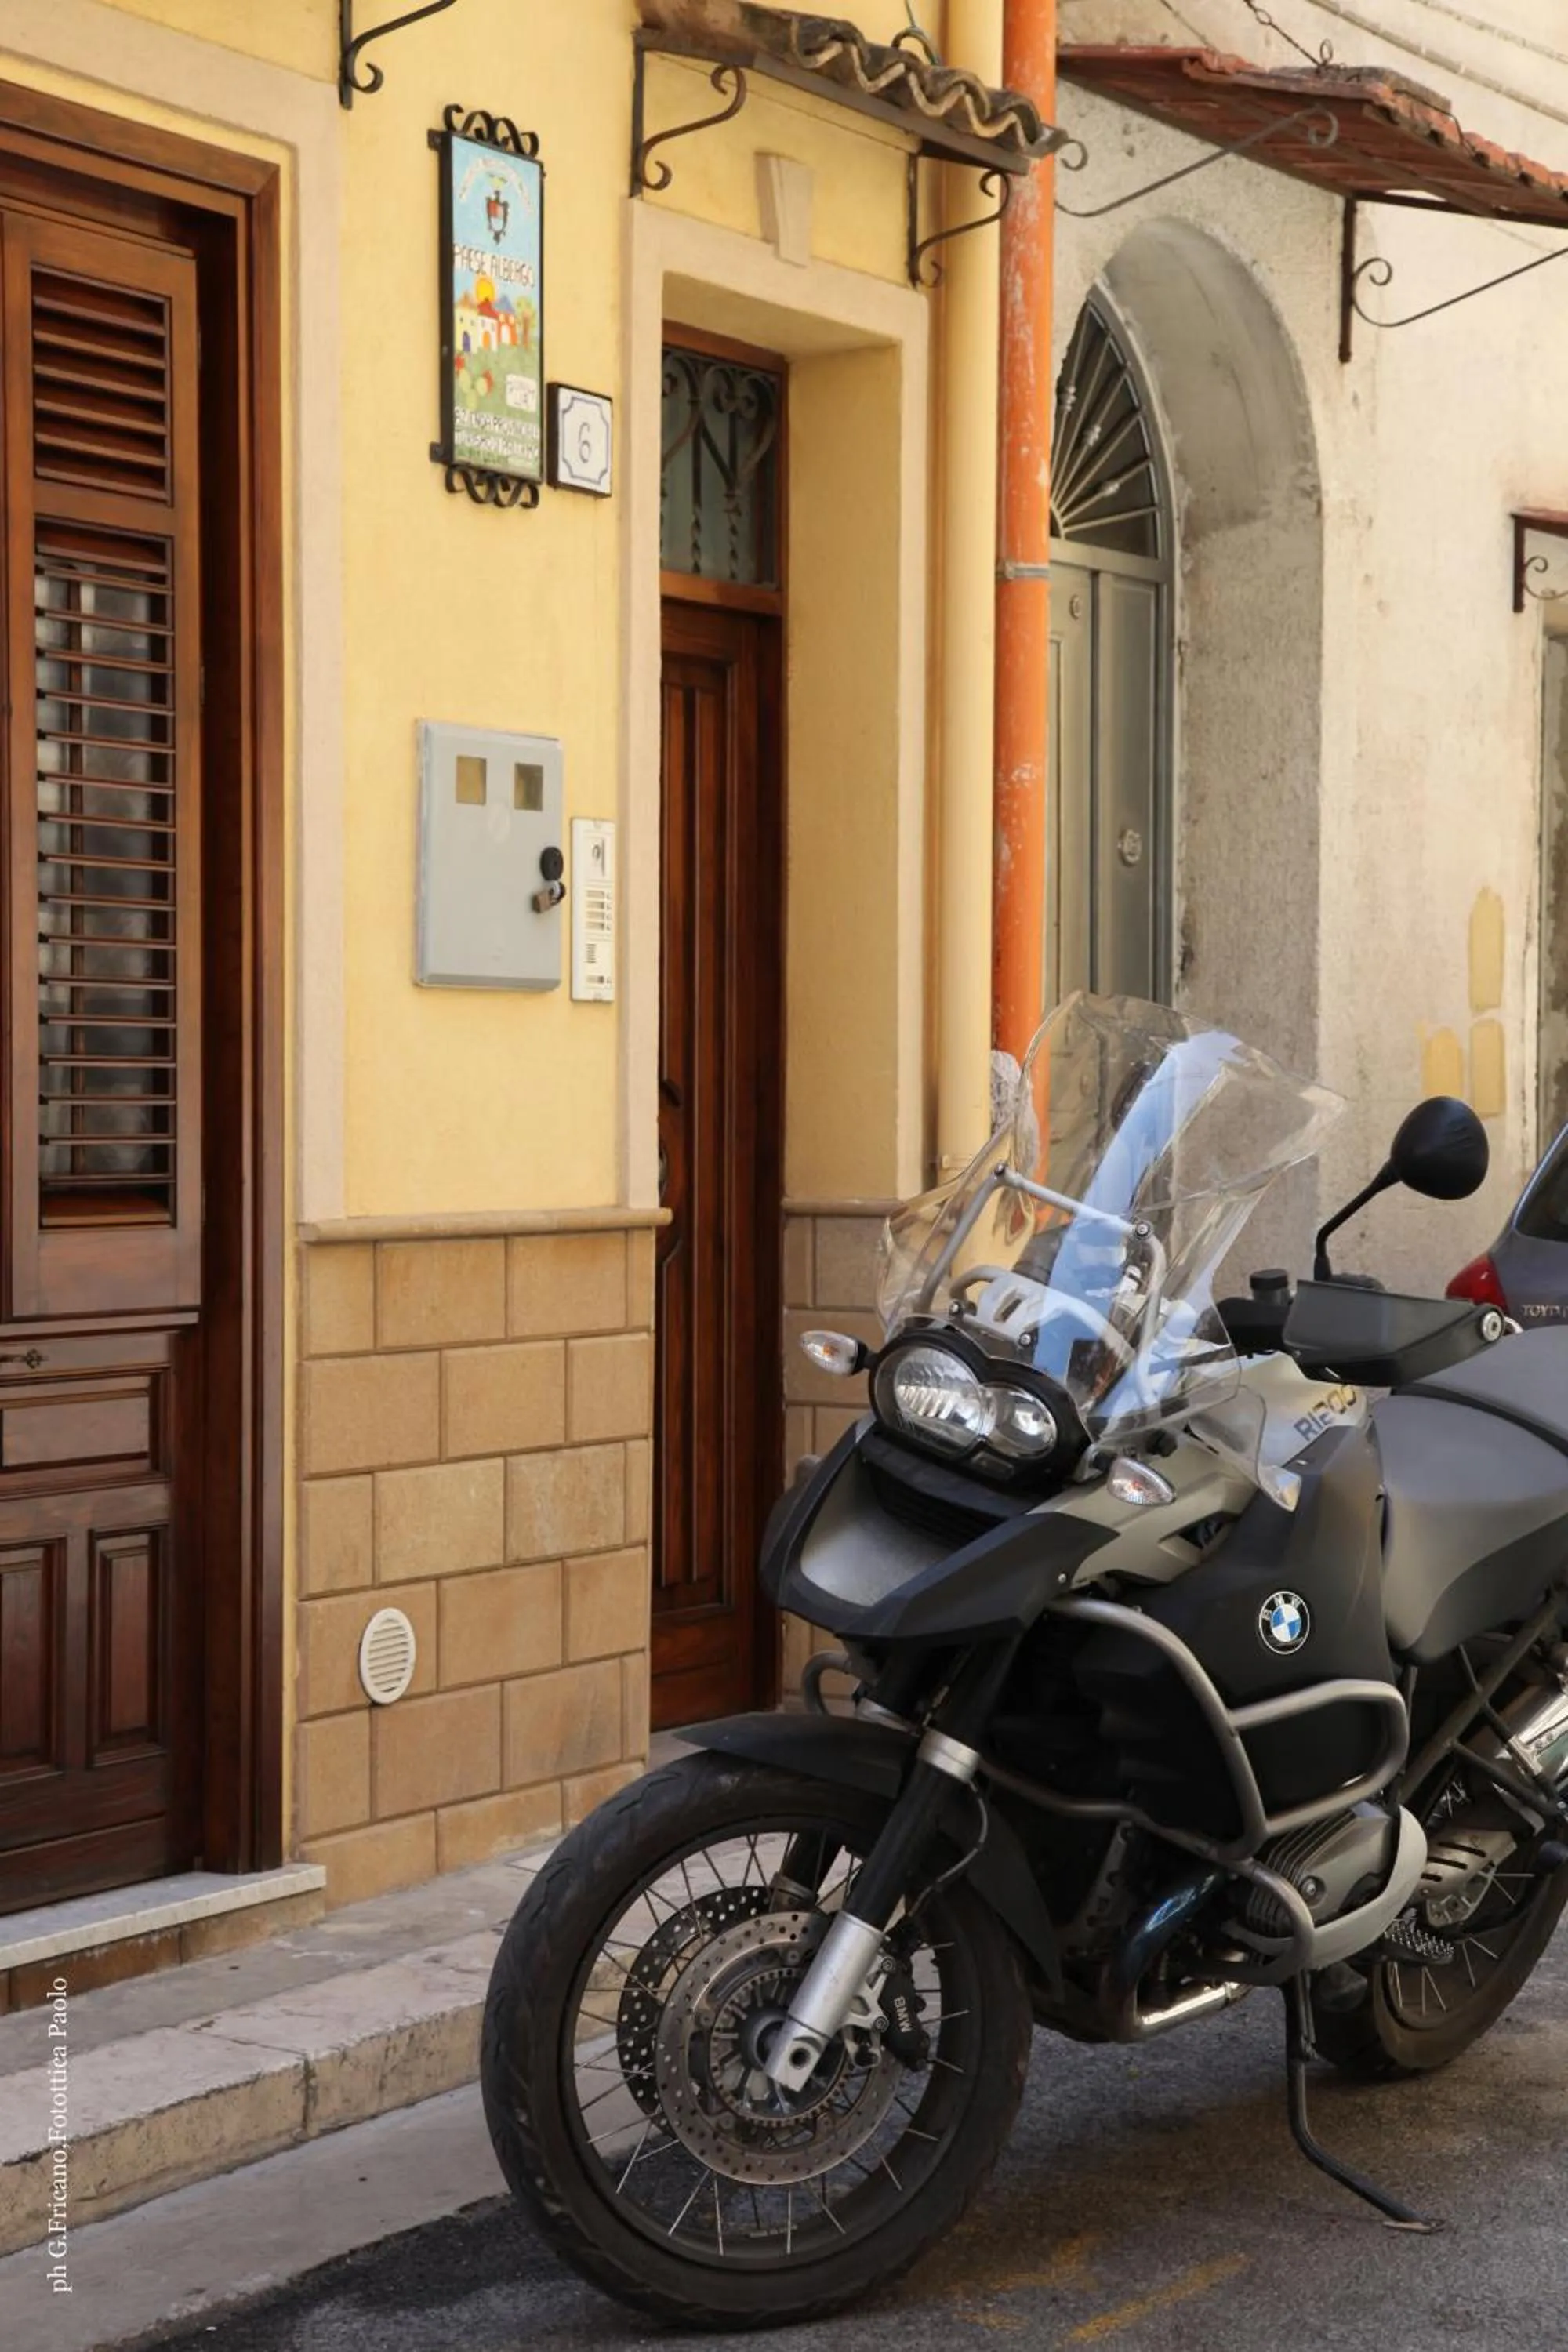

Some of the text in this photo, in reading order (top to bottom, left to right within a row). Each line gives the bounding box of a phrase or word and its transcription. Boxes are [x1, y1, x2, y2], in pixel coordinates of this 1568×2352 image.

[453, 242, 535, 288] PAESE ALBERGO
[577, 421, 592, 464] 6
[894, 1995, 913, 2032] BMW
